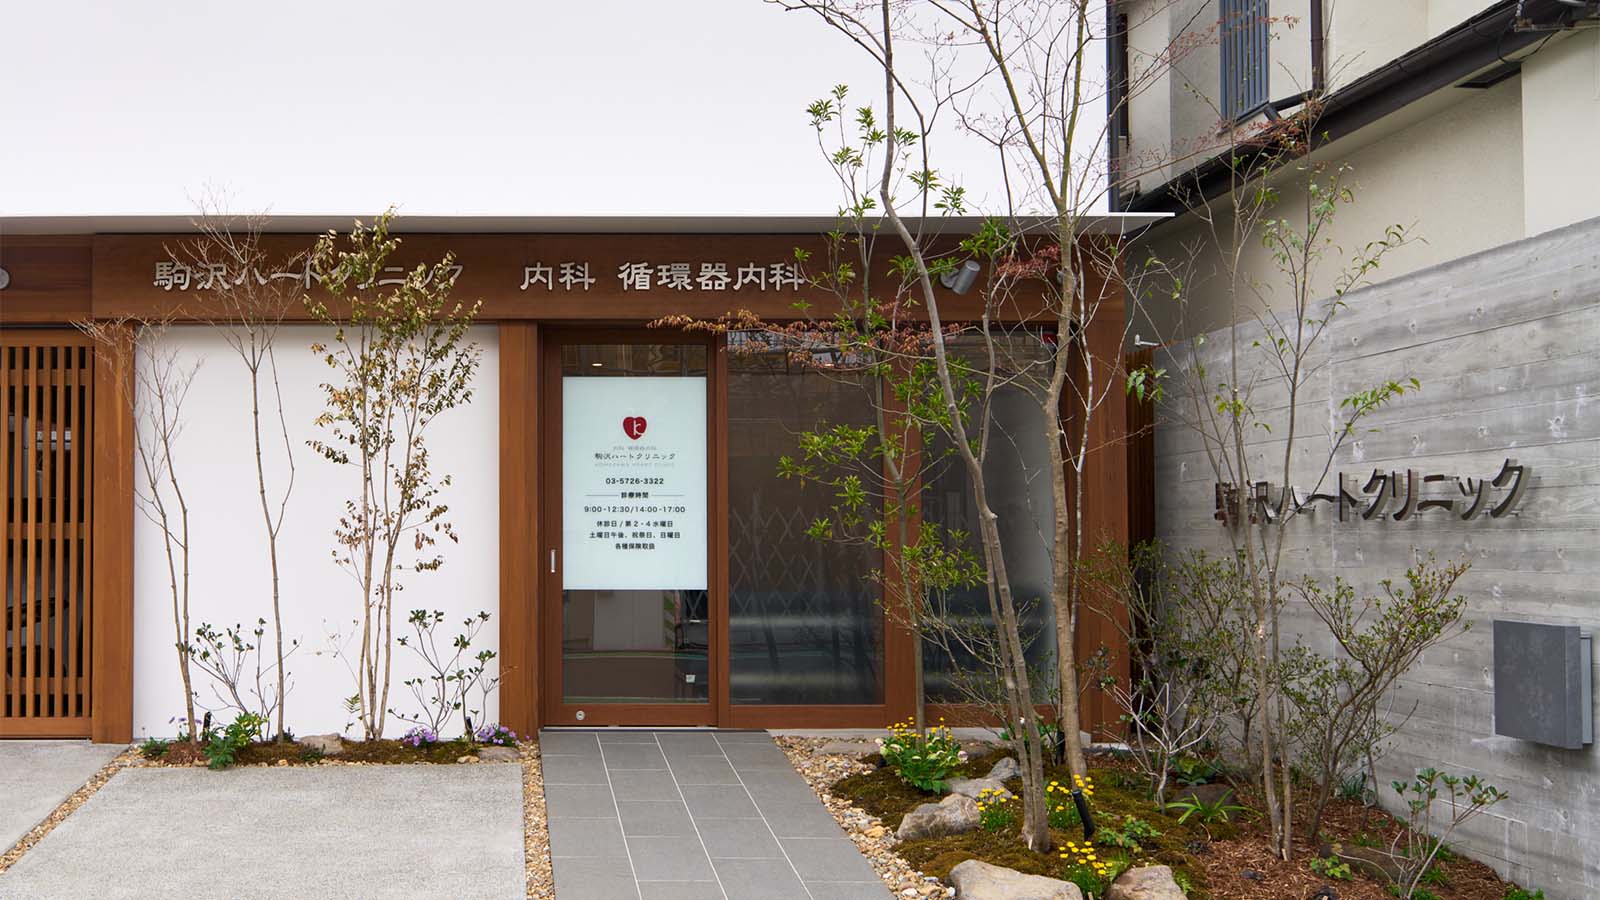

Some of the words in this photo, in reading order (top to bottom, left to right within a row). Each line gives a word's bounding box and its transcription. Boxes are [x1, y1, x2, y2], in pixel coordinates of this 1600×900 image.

[520, 262, 596, 291] 内科
[617, 262, 806, 291] 循環器内科
[605, 477, 664, 485] 03-5726-3322
